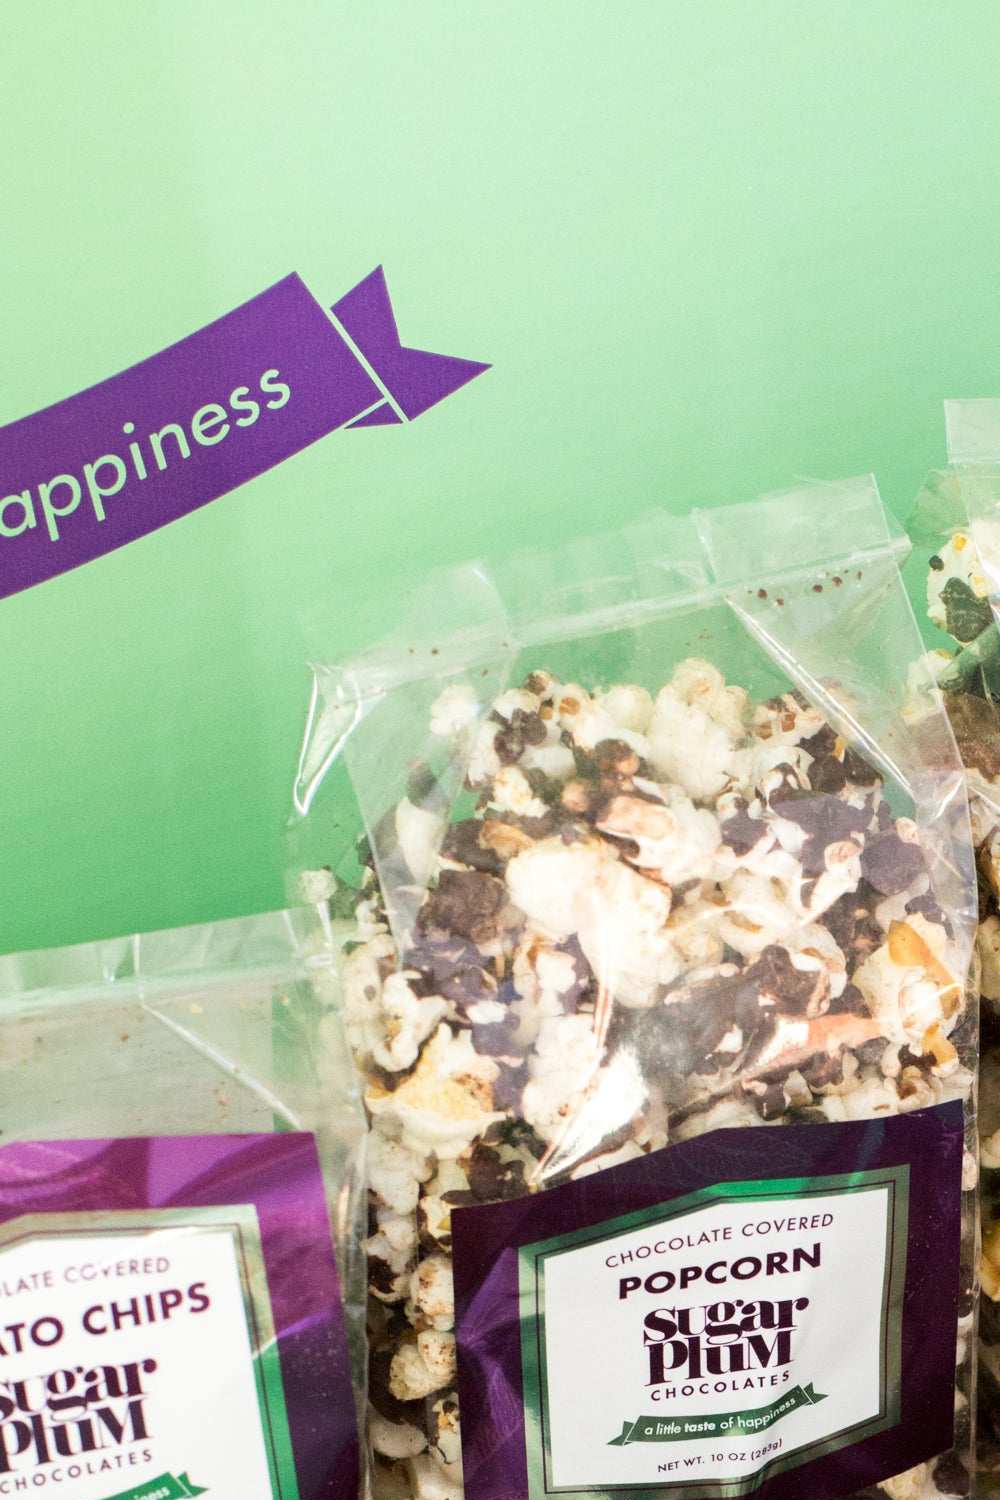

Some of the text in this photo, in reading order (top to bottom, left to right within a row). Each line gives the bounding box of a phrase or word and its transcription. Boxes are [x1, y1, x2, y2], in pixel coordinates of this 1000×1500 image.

[605, 1213, 834, 1269] CHOCOLATE COVERED
[0, 1257, 171, 1297] LATE COVERED
[619, 1243, 822, 1300] POPCORN
[0, 1282, 210, 1356] TO CHIPS
[650, 1370, 791, 1401] CHOCOLATES
[644, 1398, 796, 1435] a little taste of happiness
[0, 1450, 152, 1494] CHOCOLATES
[657, 1438, 783, 1473] NET WT. 10 OZ (283g)
